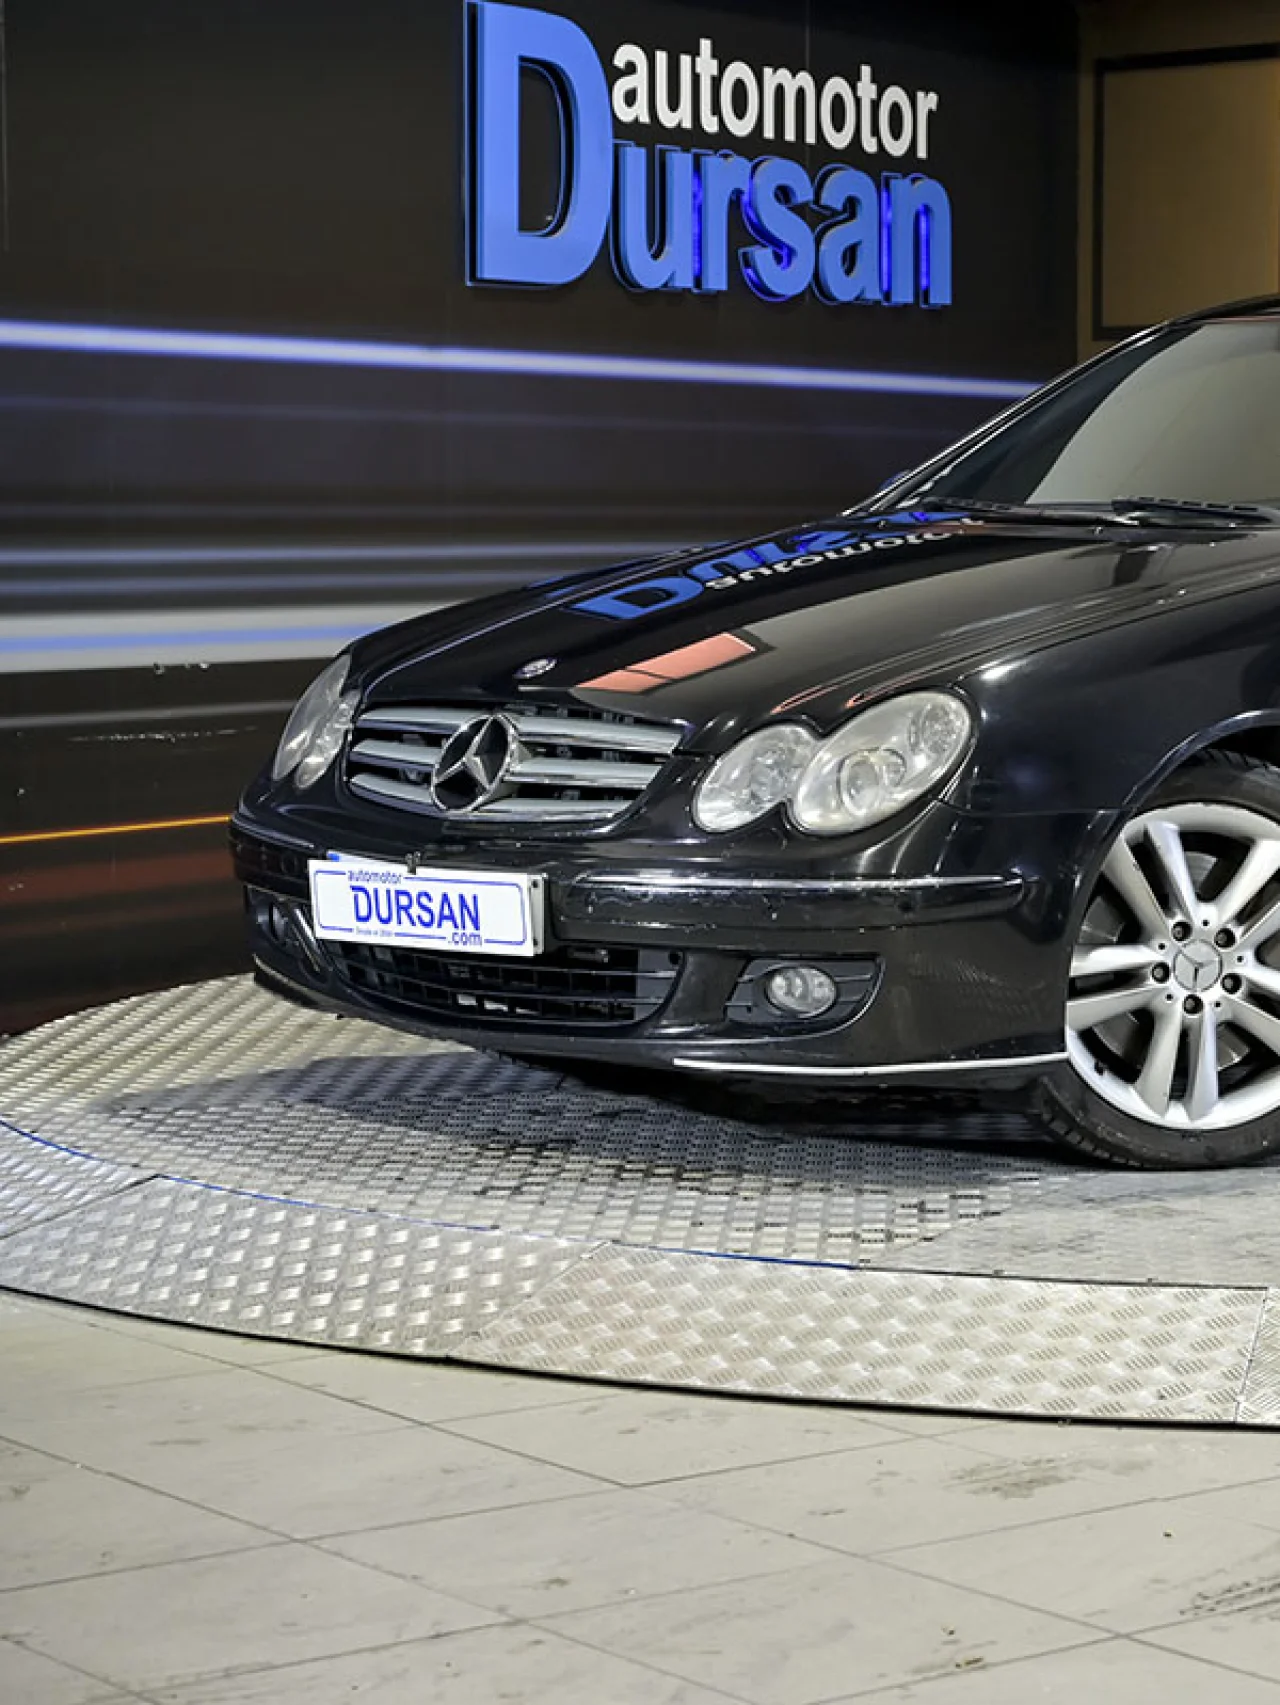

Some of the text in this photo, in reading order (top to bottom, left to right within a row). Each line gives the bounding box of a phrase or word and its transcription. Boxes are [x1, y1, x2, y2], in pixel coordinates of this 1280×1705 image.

[611, 38, 938, 159] automotor
[466, 0, 952, 307] Dursan
[348, 870, 402, 884] automotor
[350, 885, 480, 931] DURSAN
[448, 932, 482, 946] .com
